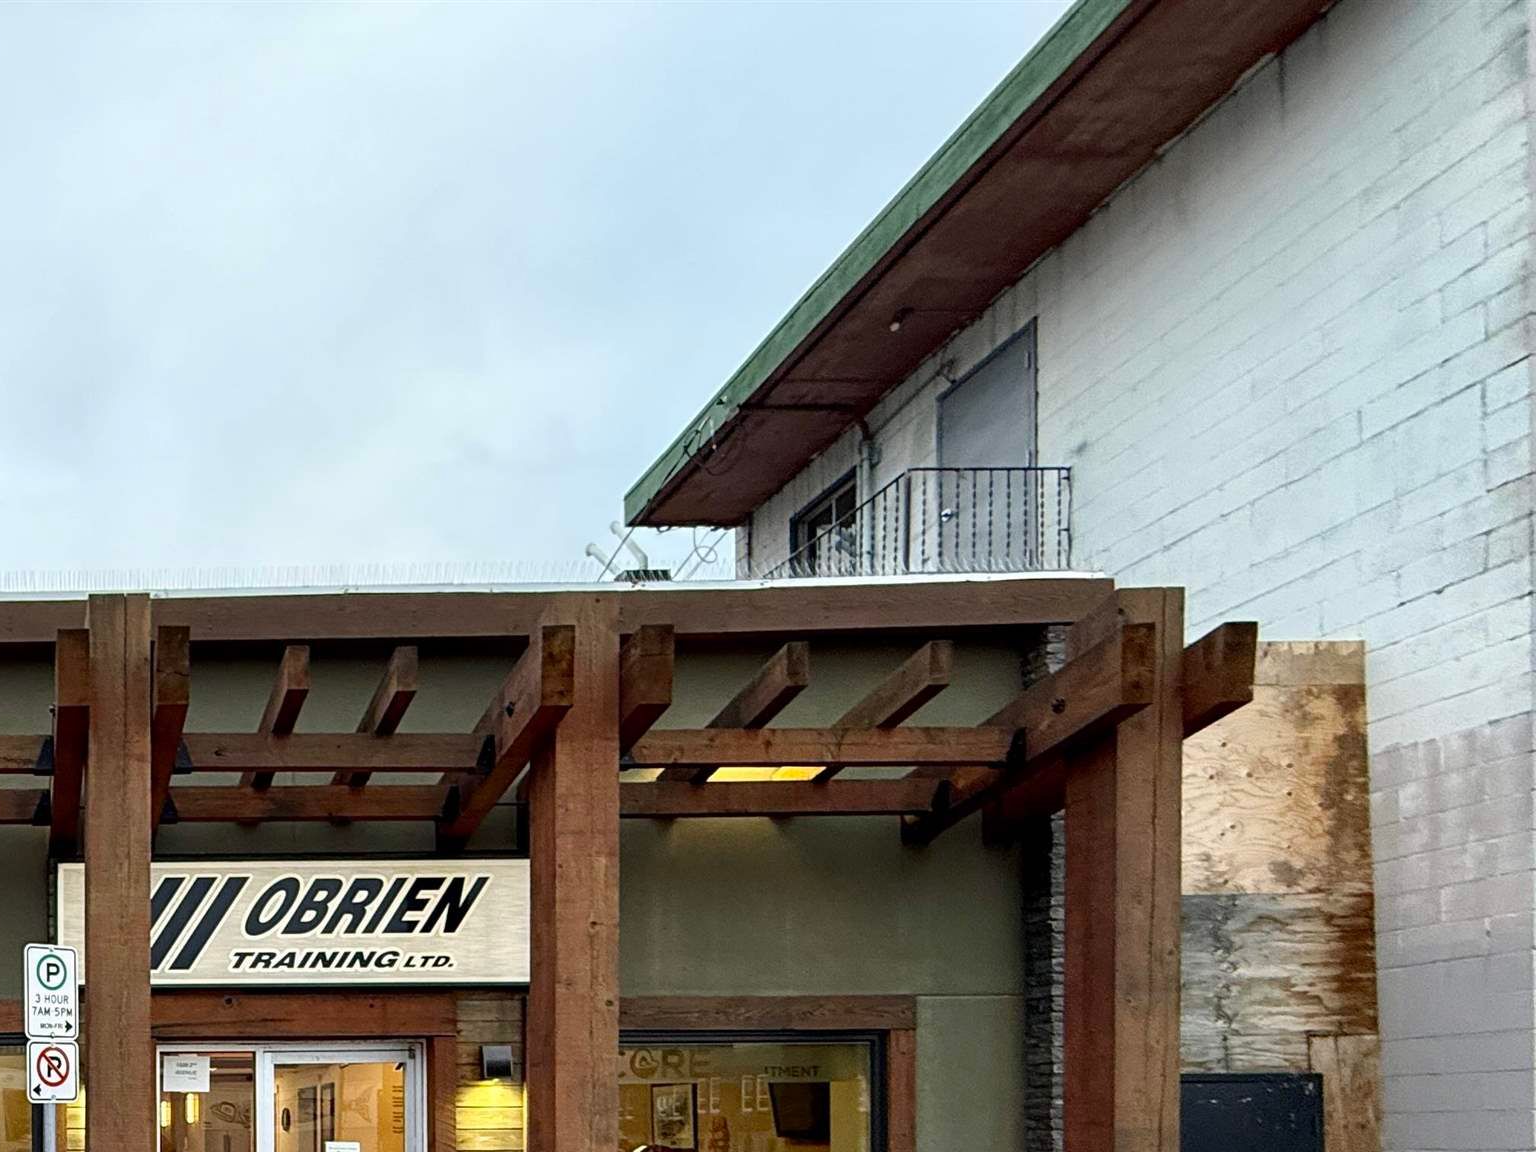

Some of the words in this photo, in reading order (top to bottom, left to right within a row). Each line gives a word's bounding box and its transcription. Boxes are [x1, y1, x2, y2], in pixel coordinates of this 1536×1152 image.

[244, 876, 491, 937] OBRIEN
[233, 951, 401, 969] TRAINING
[404, 953, 454, 969] LTD.
[46, 963, 60, 983] P
[35, 993, 41, 1004] 3
[44, 994, 70, 1005] HOUR
